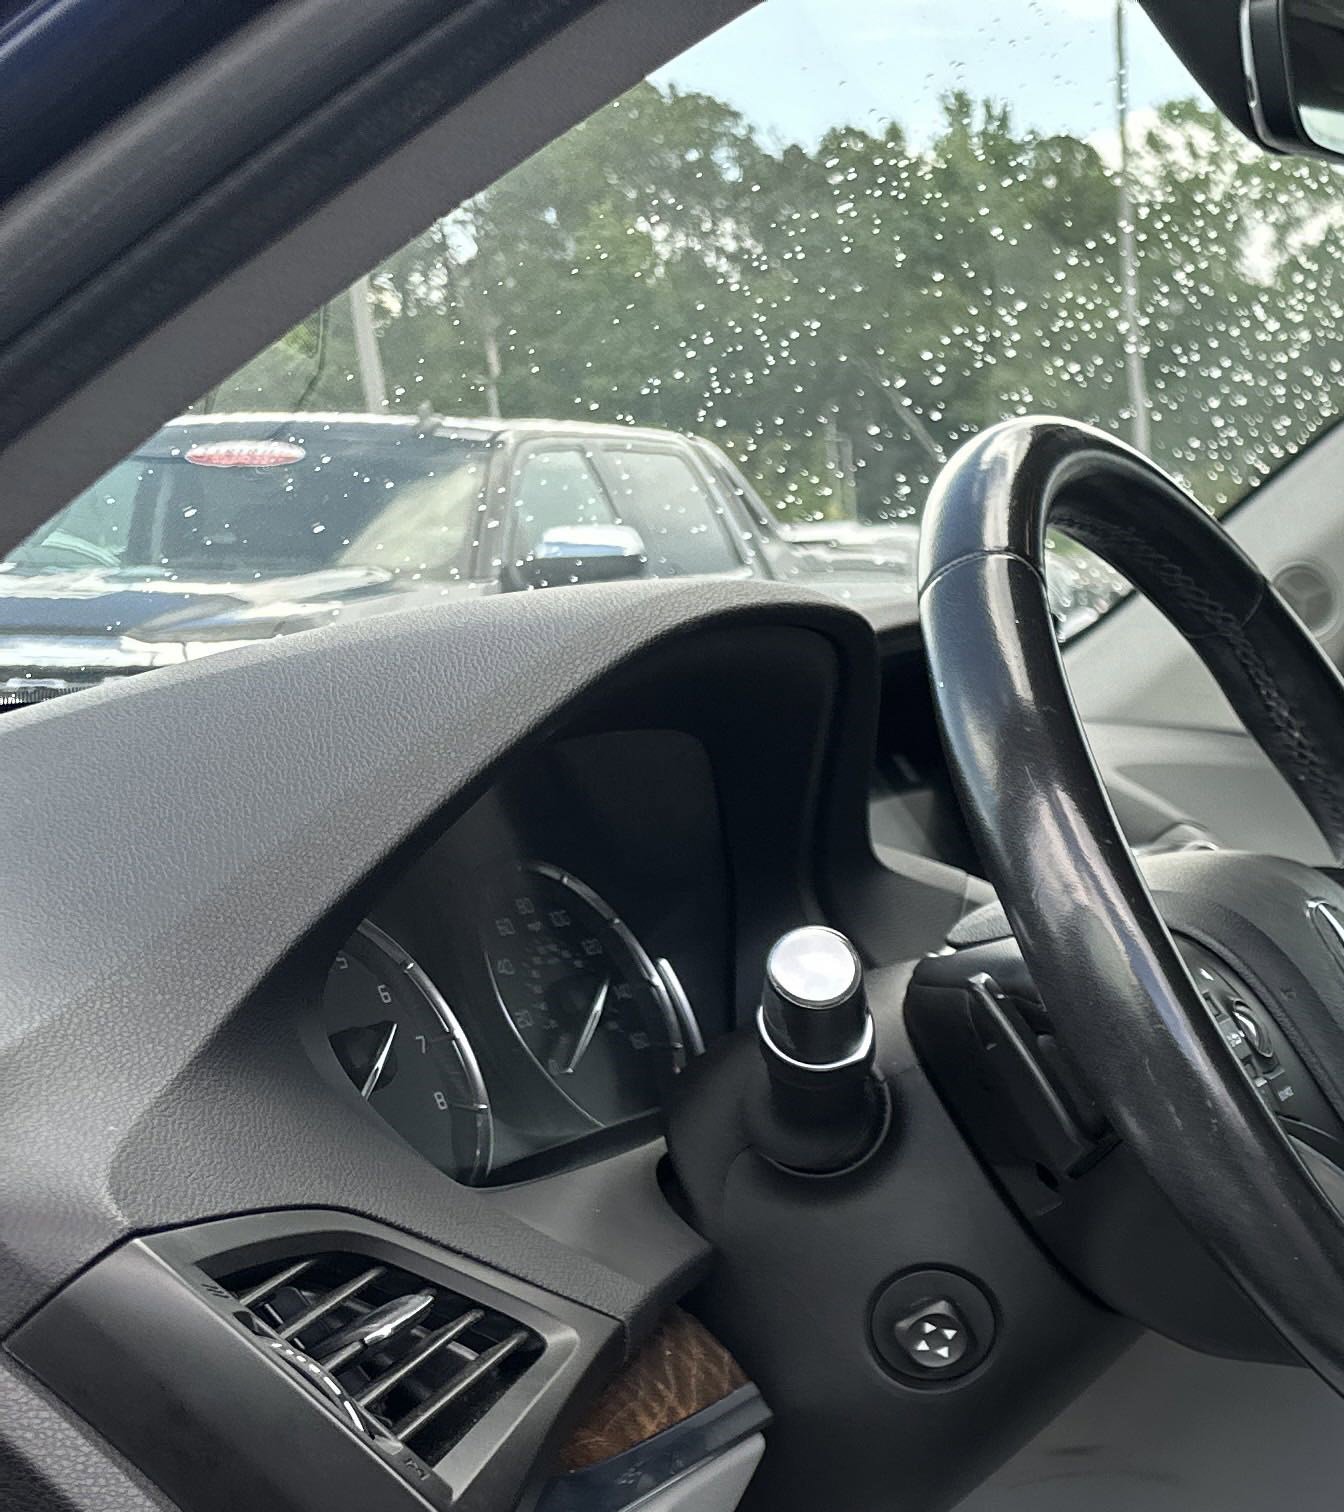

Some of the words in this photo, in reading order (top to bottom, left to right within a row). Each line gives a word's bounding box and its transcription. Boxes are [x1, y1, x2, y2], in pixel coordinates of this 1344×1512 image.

[378, 984, 392, 1004] 6
[415, 1035, 427, 1054] 7
[434, 1091, 448, 1110] 8
